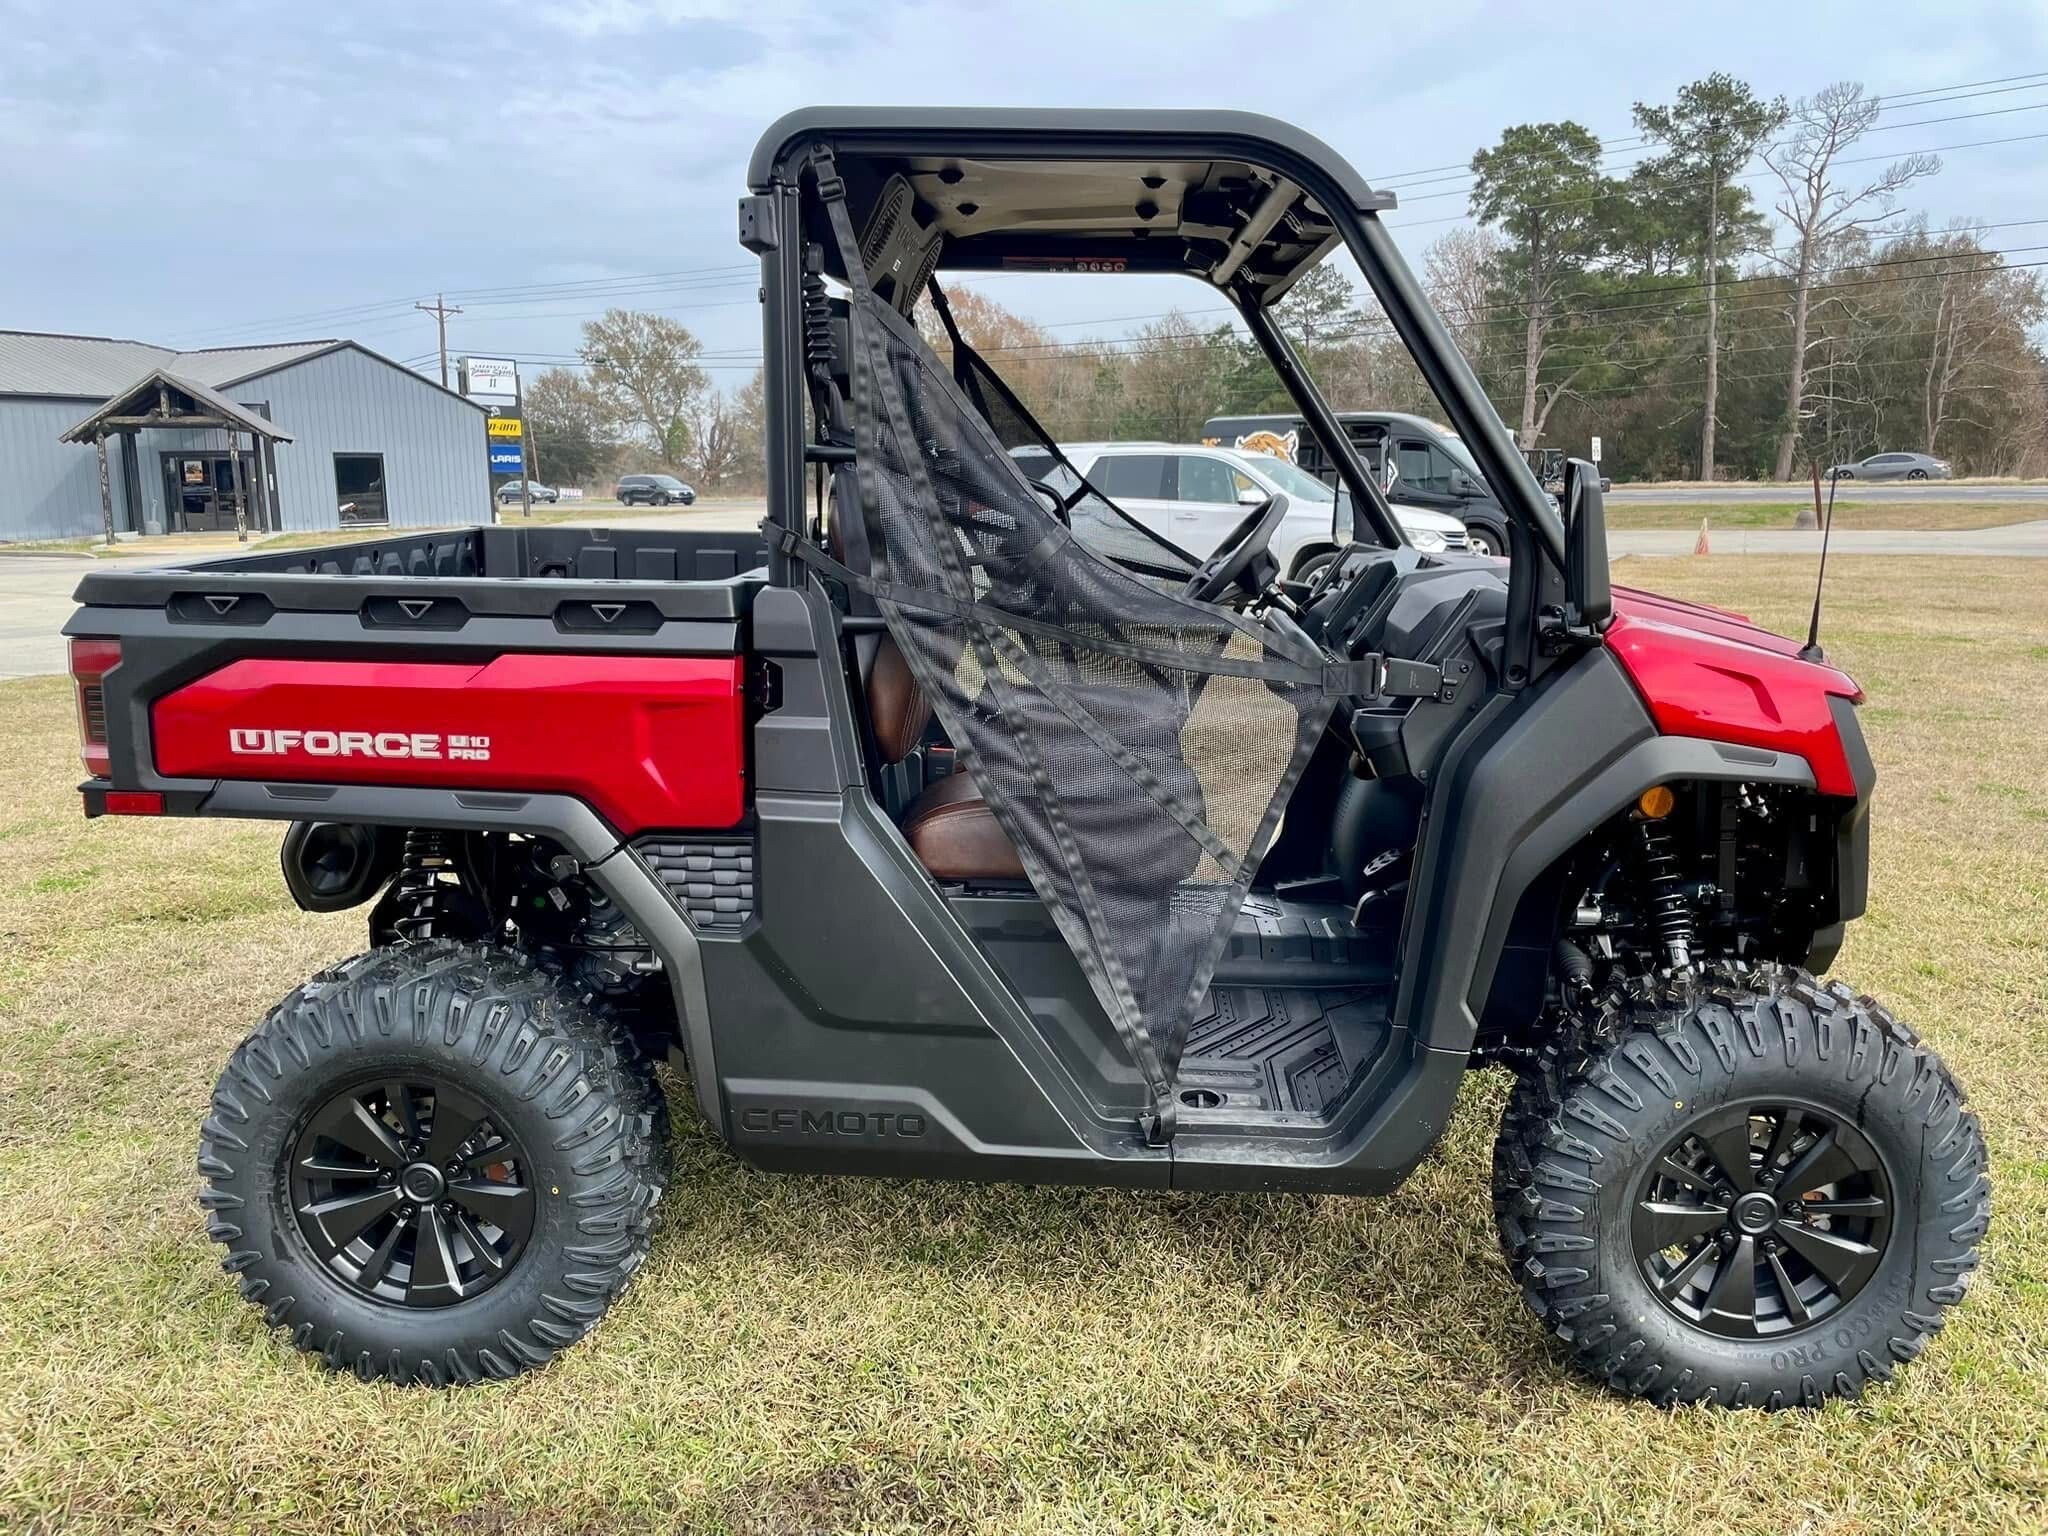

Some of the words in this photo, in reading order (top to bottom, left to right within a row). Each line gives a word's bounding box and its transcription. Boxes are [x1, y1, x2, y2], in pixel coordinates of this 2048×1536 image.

[491, 455, 522, 464] LARIS
[229, 728, 443, 759] UFORCE
[448, 735, 490, 748] U10
[448, 748, 490, 761] PRO
[742, 1107, 926, 1138] CFMOTO
